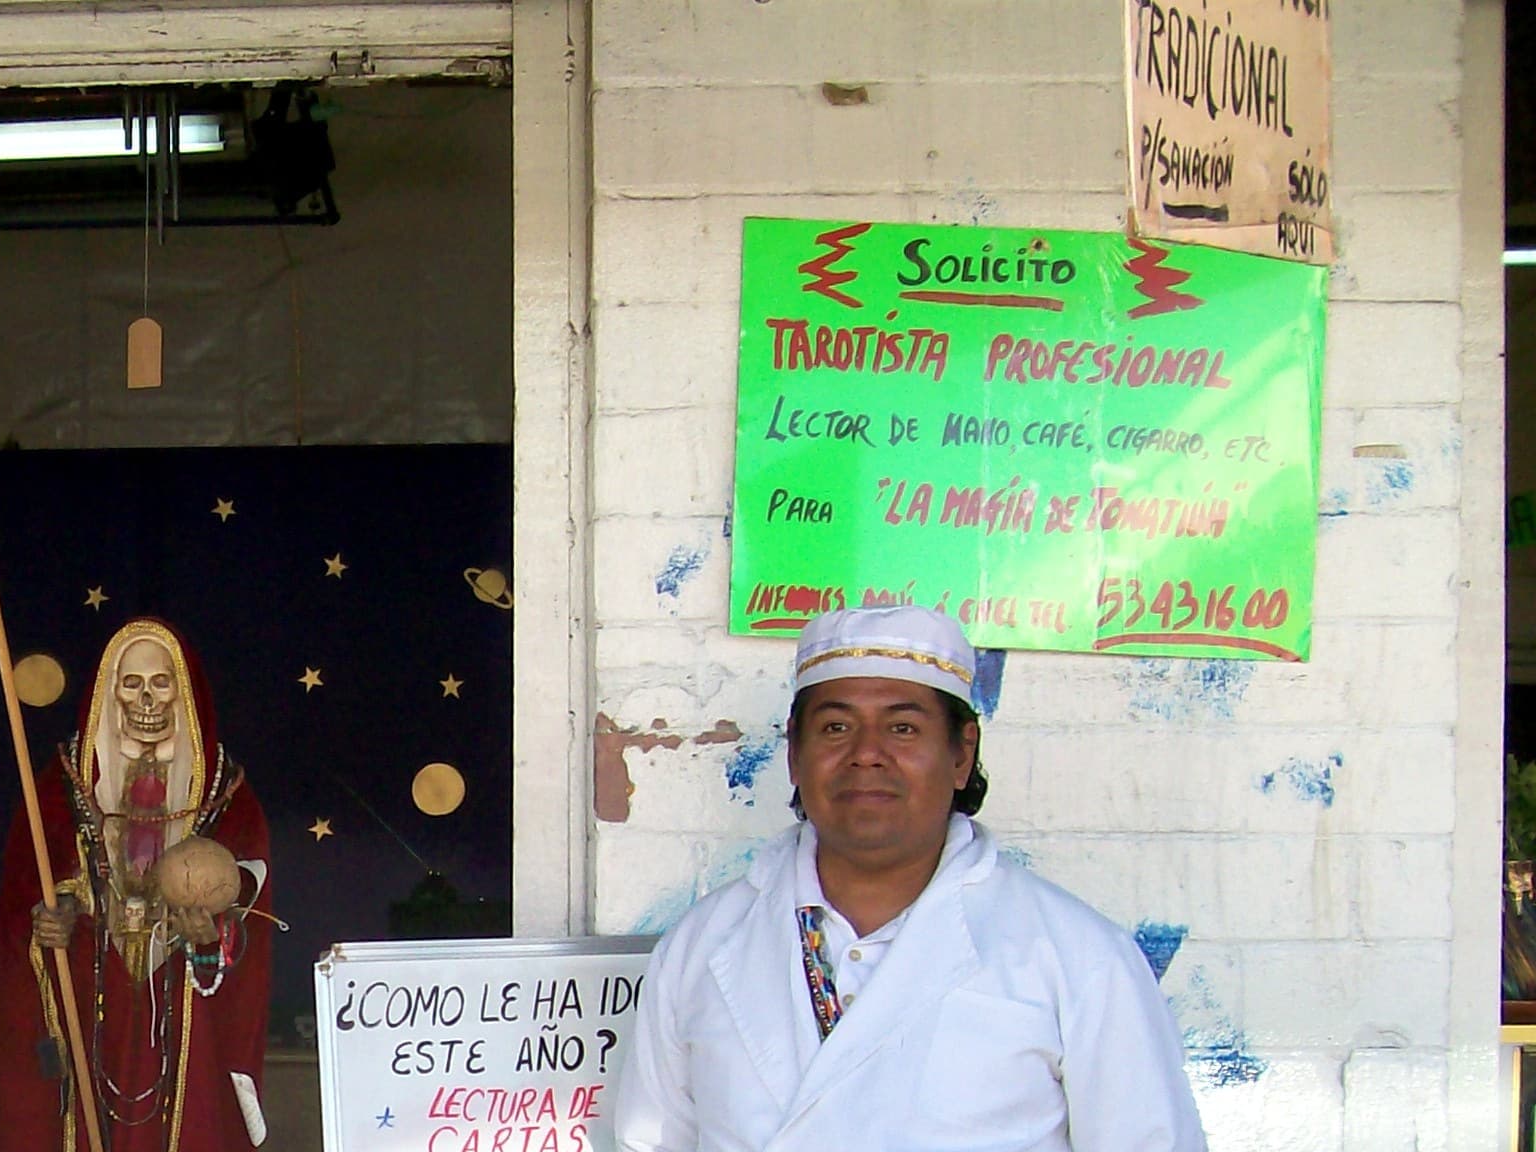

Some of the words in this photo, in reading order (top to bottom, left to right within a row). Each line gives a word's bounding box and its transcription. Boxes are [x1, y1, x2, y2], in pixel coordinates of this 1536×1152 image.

[984, 333, 1232, 390] PROFESIONAL
[765, 395, 877, 449] LECTOR
[887, 413, 920, 447] DE
[766, 488, 833, 524] PARA
[1044, 495, 1082, 535] DE
[335, 979, 465, 1031] ¿COMO
[480, 982, 521, 1023] LE
[532, 977, 583, 1022] HA
[391, 1039, 487, 1076] ESTE
[427, 1086, 557, 1124] LECTURA
[567, 1083, 605, 1120] DE
